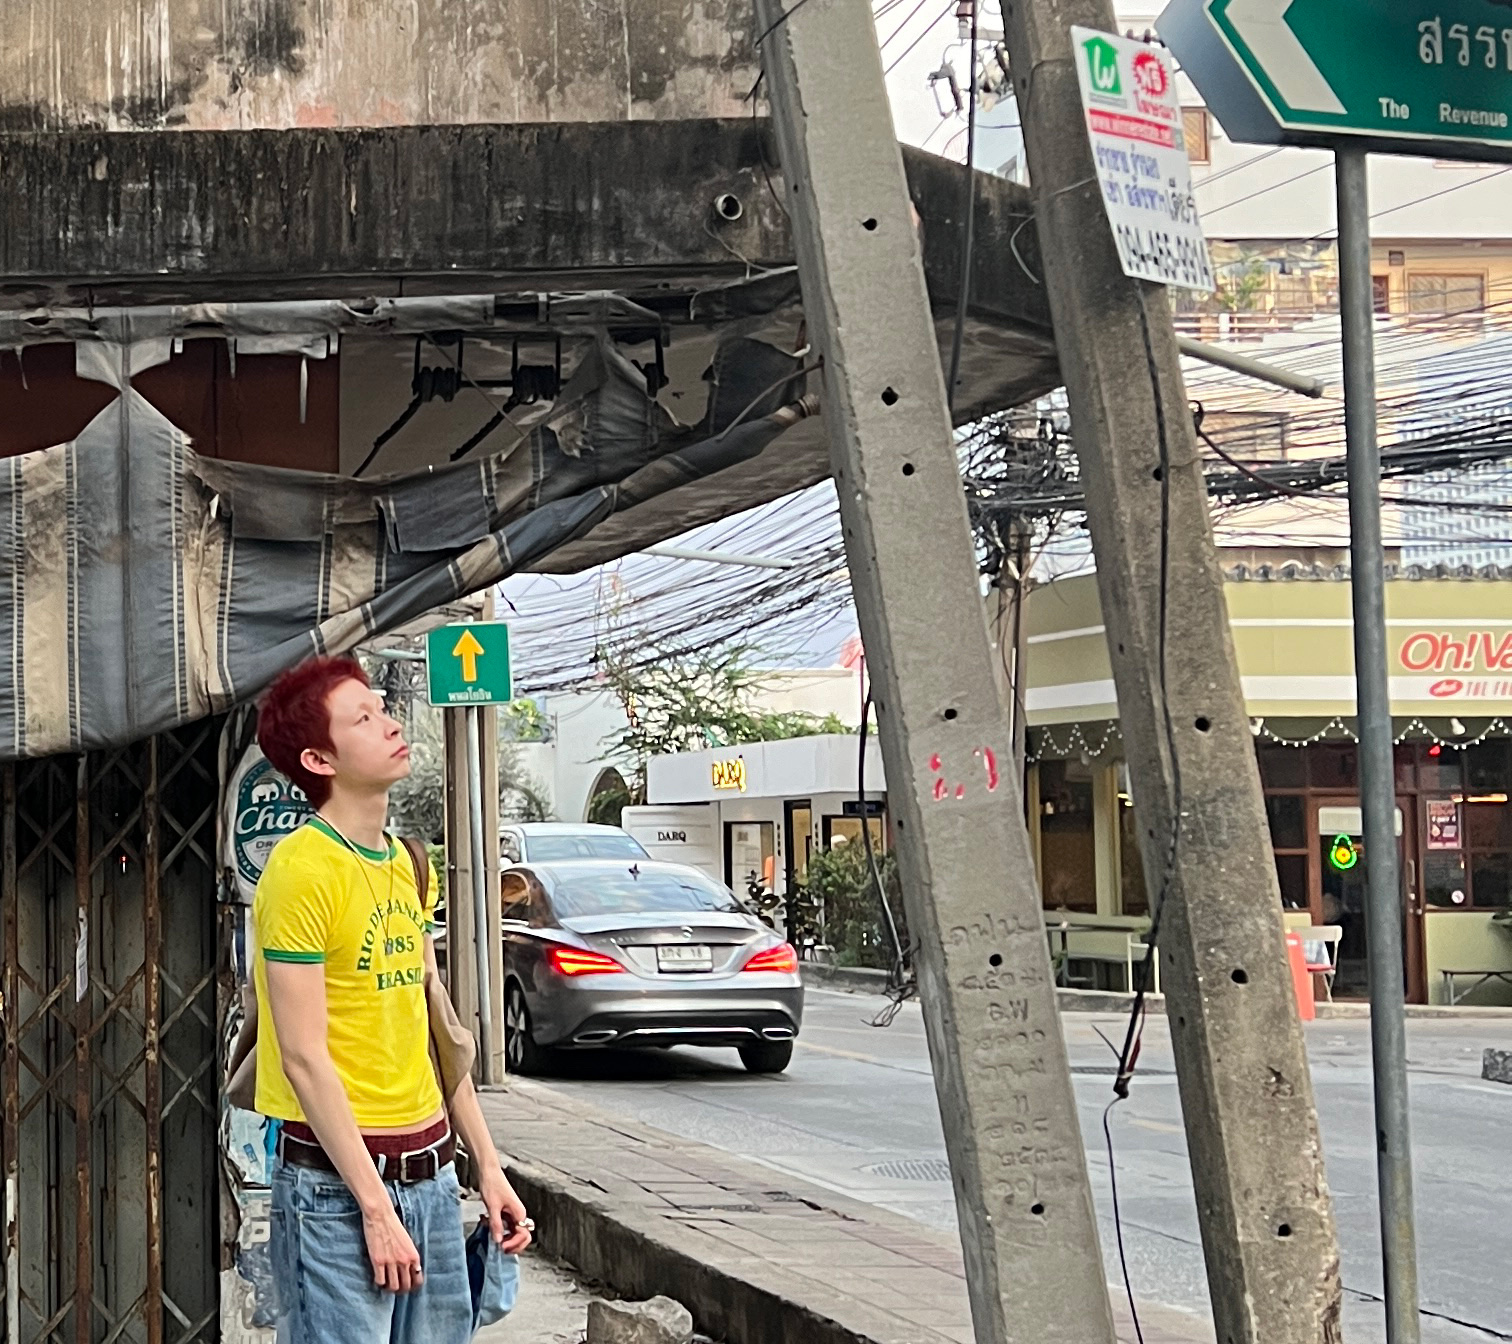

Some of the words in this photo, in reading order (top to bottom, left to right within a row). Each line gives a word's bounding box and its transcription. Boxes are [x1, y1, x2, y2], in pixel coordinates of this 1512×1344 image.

[1378, 96, 1410, 120] The
[1439, 102, 1508, 128] Revenue
[657, 830, 687, 843] DARQ
[357, 929, 375, 971] RIO
